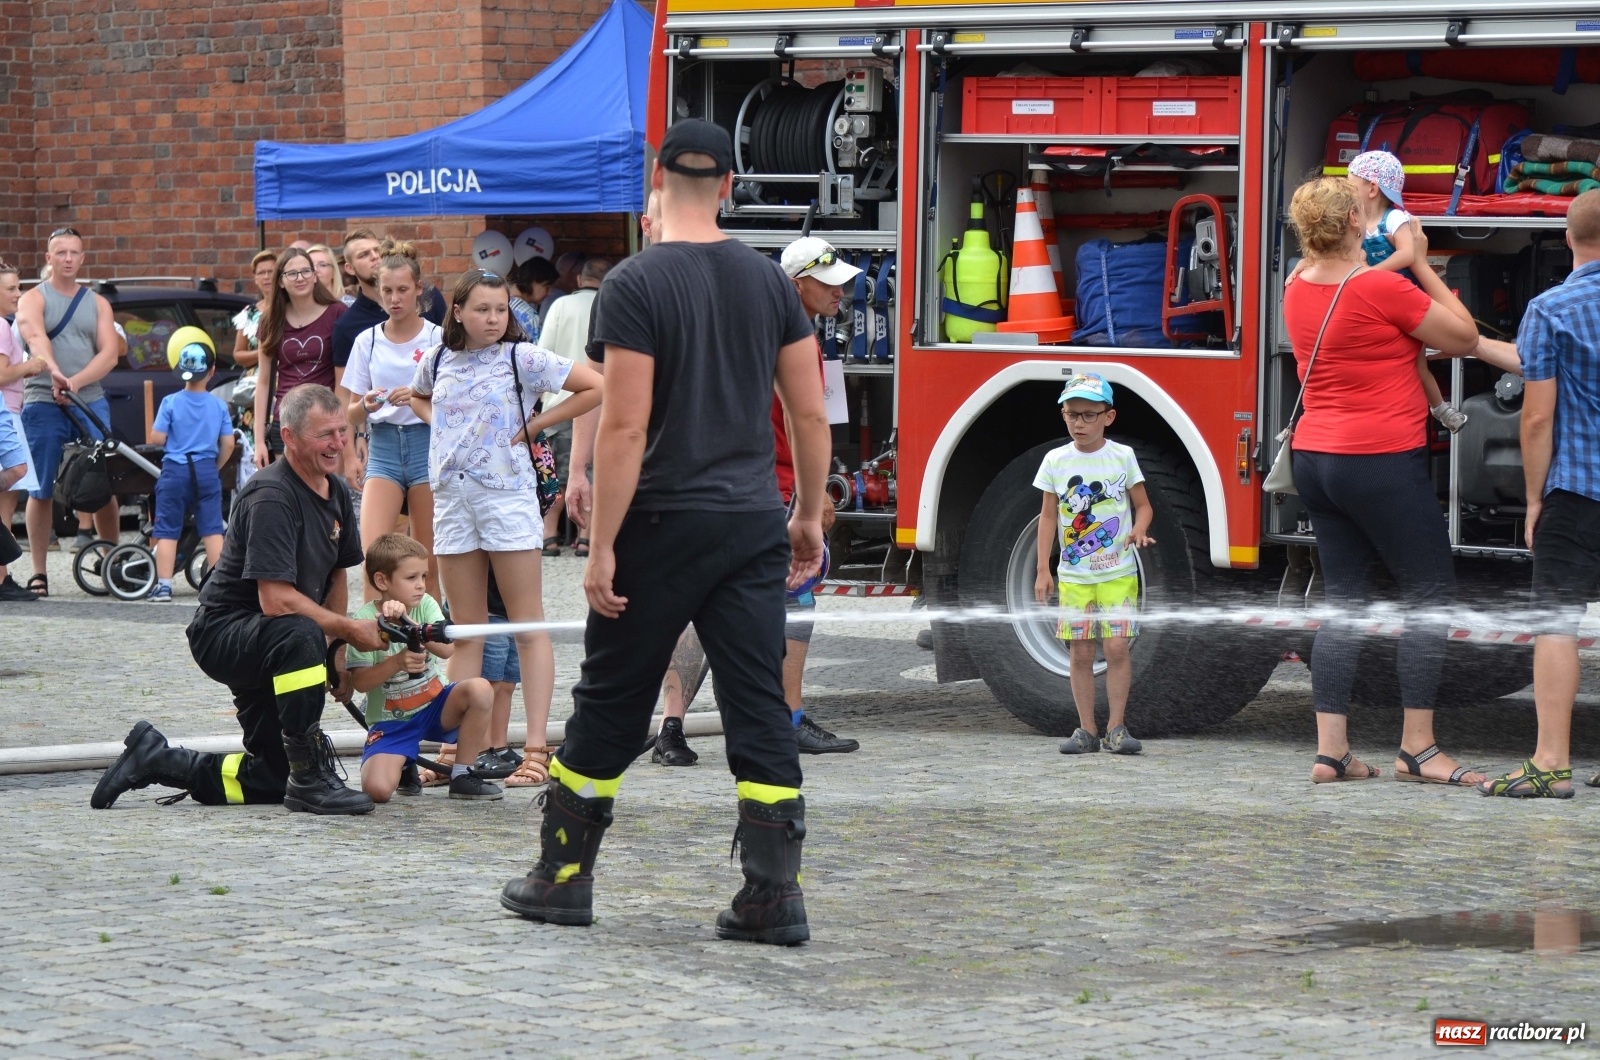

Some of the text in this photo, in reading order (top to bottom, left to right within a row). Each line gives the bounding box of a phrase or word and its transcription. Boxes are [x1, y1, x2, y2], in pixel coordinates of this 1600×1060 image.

[385, 167, 482, 196] POLICJA
[855, 309, 863, 335] ISS
[877, 315, 885, 339] ISS
[1090, 551, 1119, 562] MICKEY
[1090, 560, 1120, 570] MOUSE
